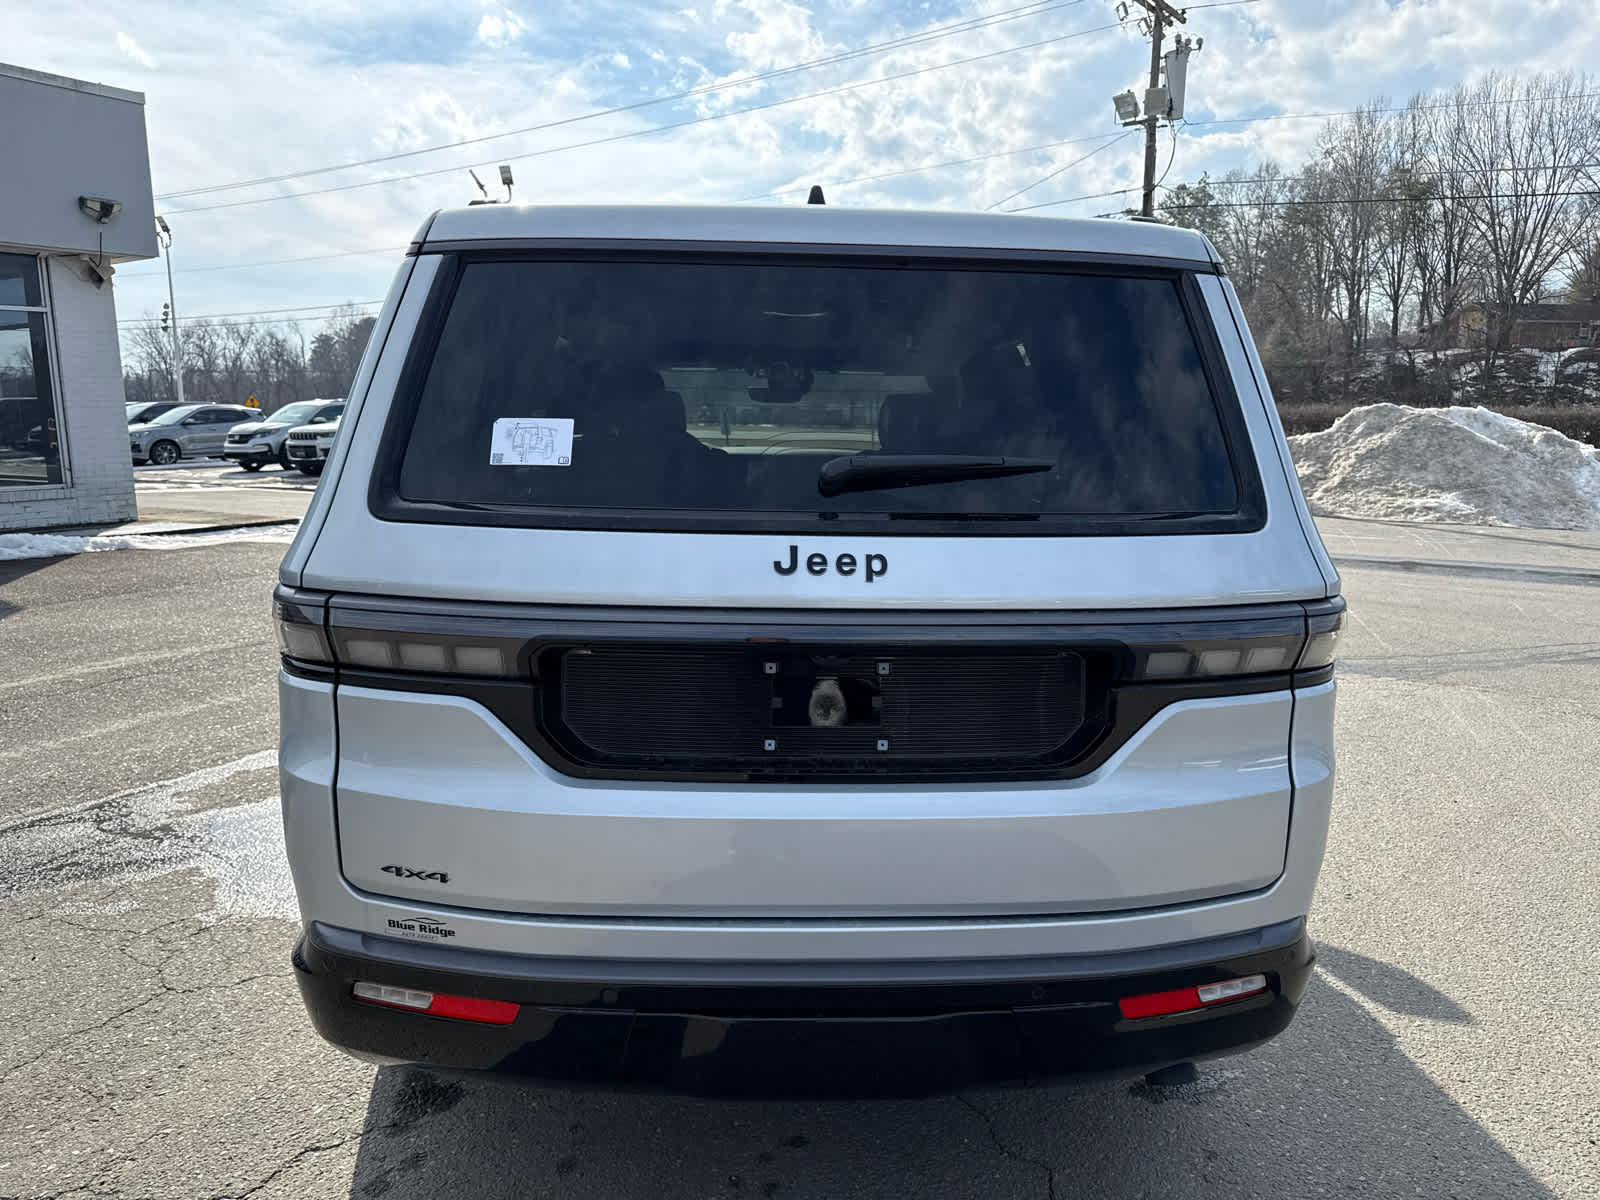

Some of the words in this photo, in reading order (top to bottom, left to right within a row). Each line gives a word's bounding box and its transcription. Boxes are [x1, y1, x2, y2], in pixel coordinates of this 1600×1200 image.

[773, 544, 889, 583] Jeep
[387, 919, 416, 931] Blue
[419, 923, 456, 938] Ridge
